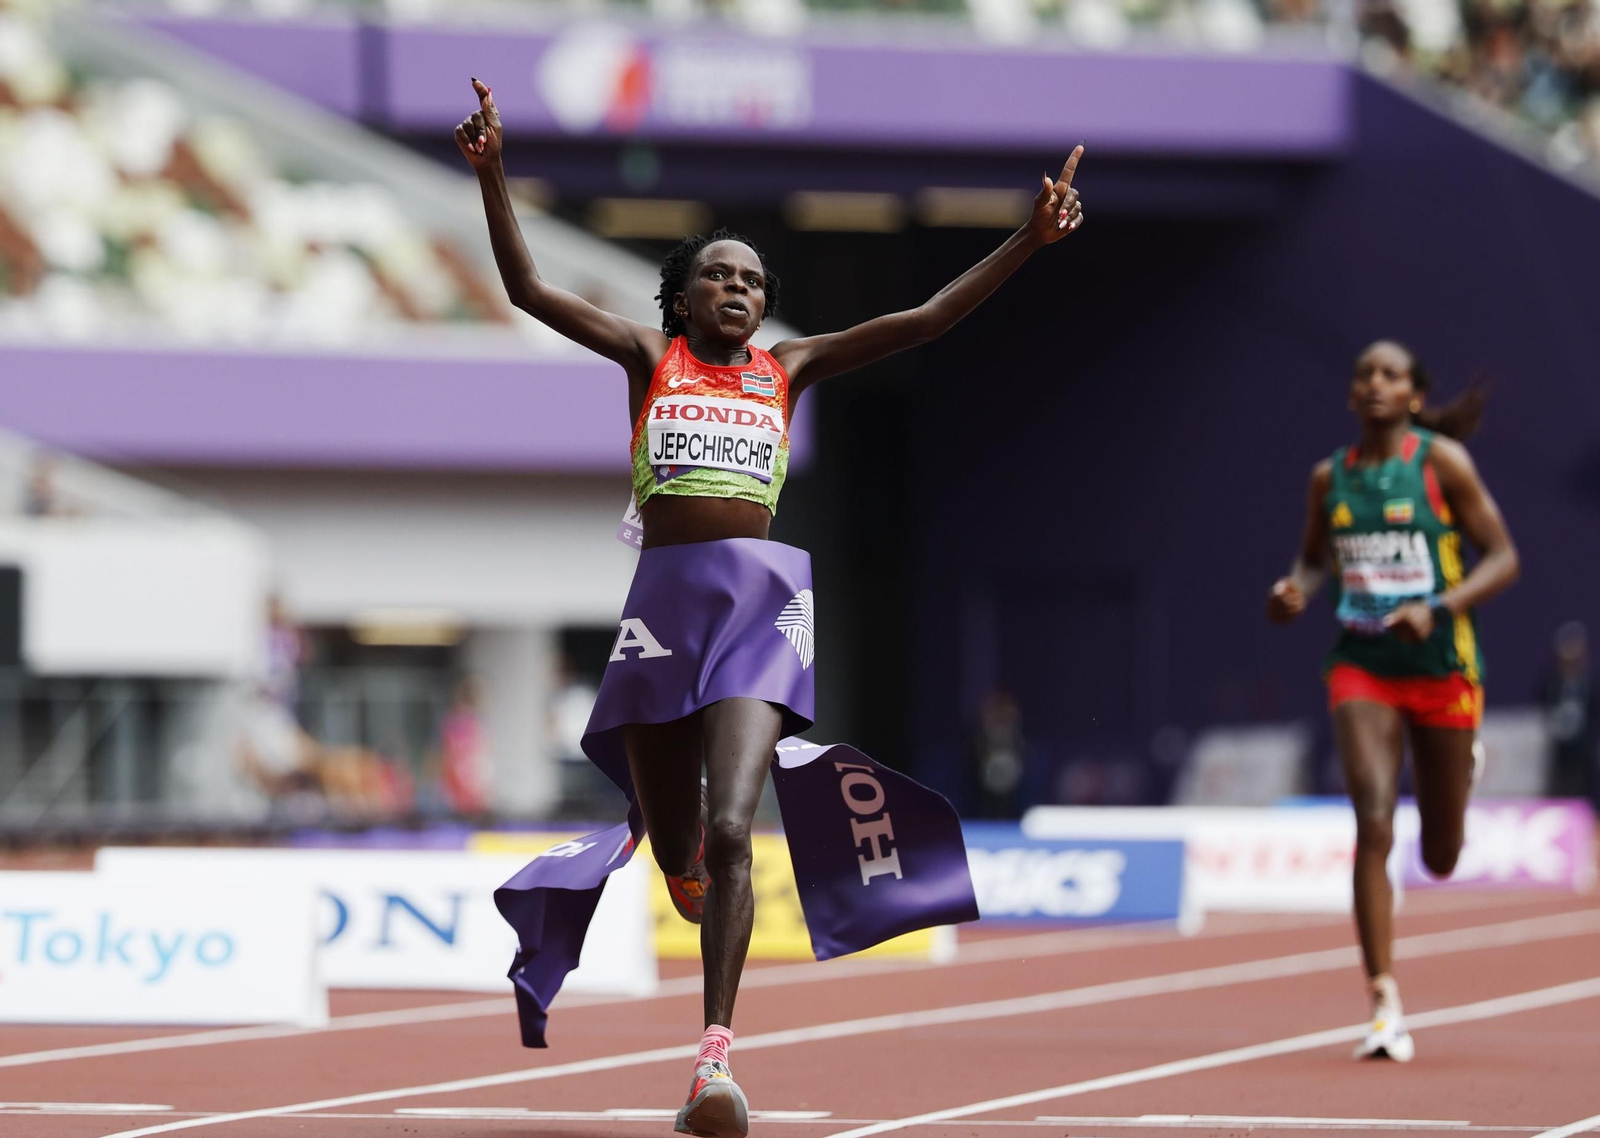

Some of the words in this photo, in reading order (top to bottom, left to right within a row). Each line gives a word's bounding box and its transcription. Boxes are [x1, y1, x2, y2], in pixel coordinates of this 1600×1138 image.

[652, 404, 781, 433] HONDA
[654, 432, 773, 471] JEPCHIRCHIR
[834, 761, 903, 886] HO
[3, 908, 237, 985] Tokyo
